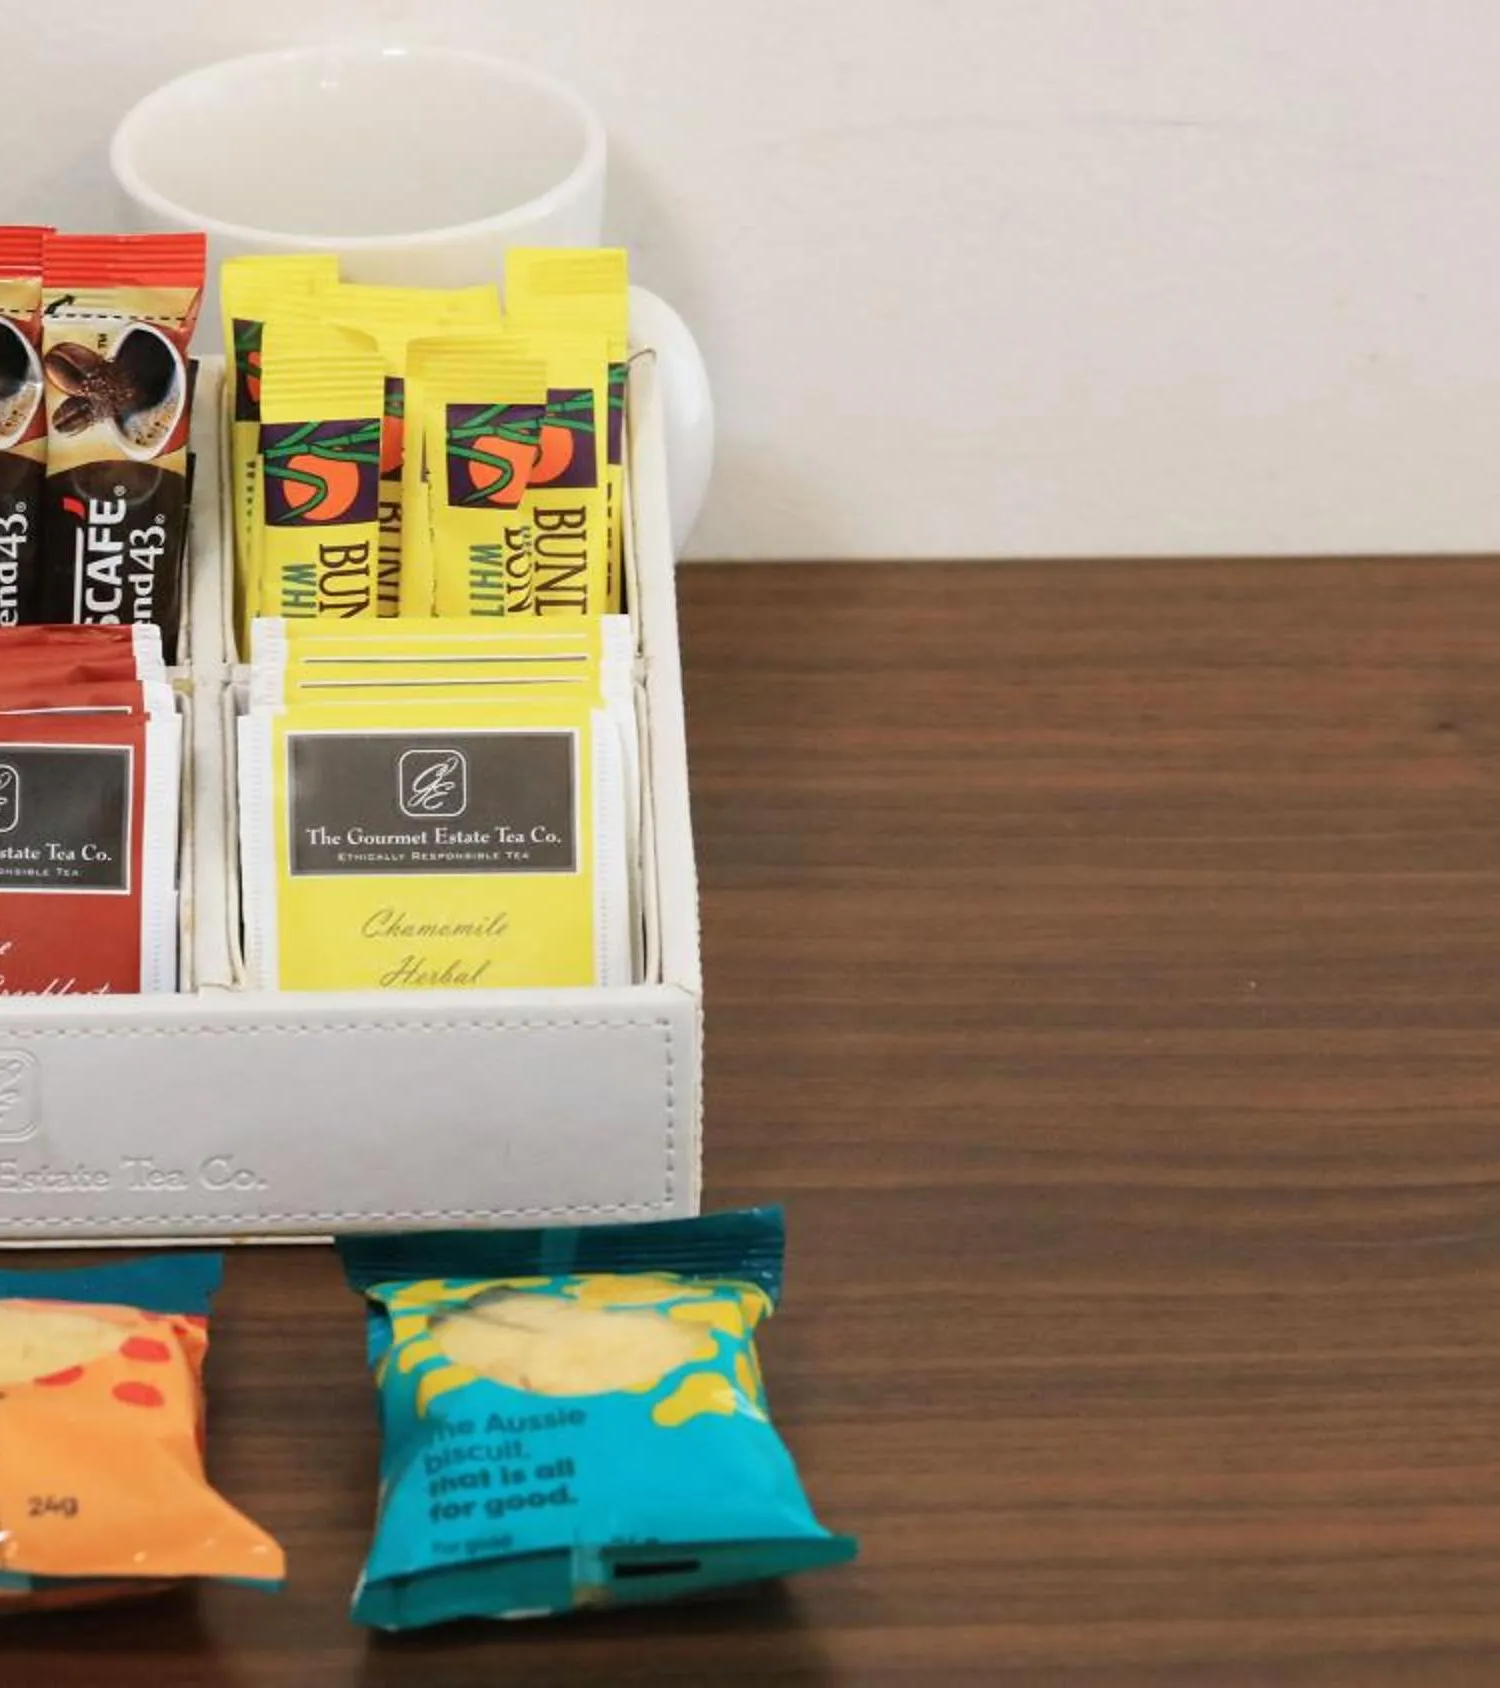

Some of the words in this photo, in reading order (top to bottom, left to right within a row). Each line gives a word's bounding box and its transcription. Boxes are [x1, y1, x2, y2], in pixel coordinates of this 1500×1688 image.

[306, 827, 342, 846] The
[347, 827, 428, 847] Gourmet
[435, 828, 491, 844] Estate
[495, 826, 526, 845] Tea
[530, 826, 562, 844] Co.
[46, 843, 76, 862] Tea
[81, 843, 113, 863] Co.
[360, 908, 510, 939] Chamomile
[120, 1155, 189, 1192] Tea
[199, 1154, 271, 1193] Co.
[484, 1408, 587, 1434] Aussie
[500, 1466, 526, 1485] is
[534, 1458, 576, 1480] all
[28, 1496, 80, 1518] 24g
